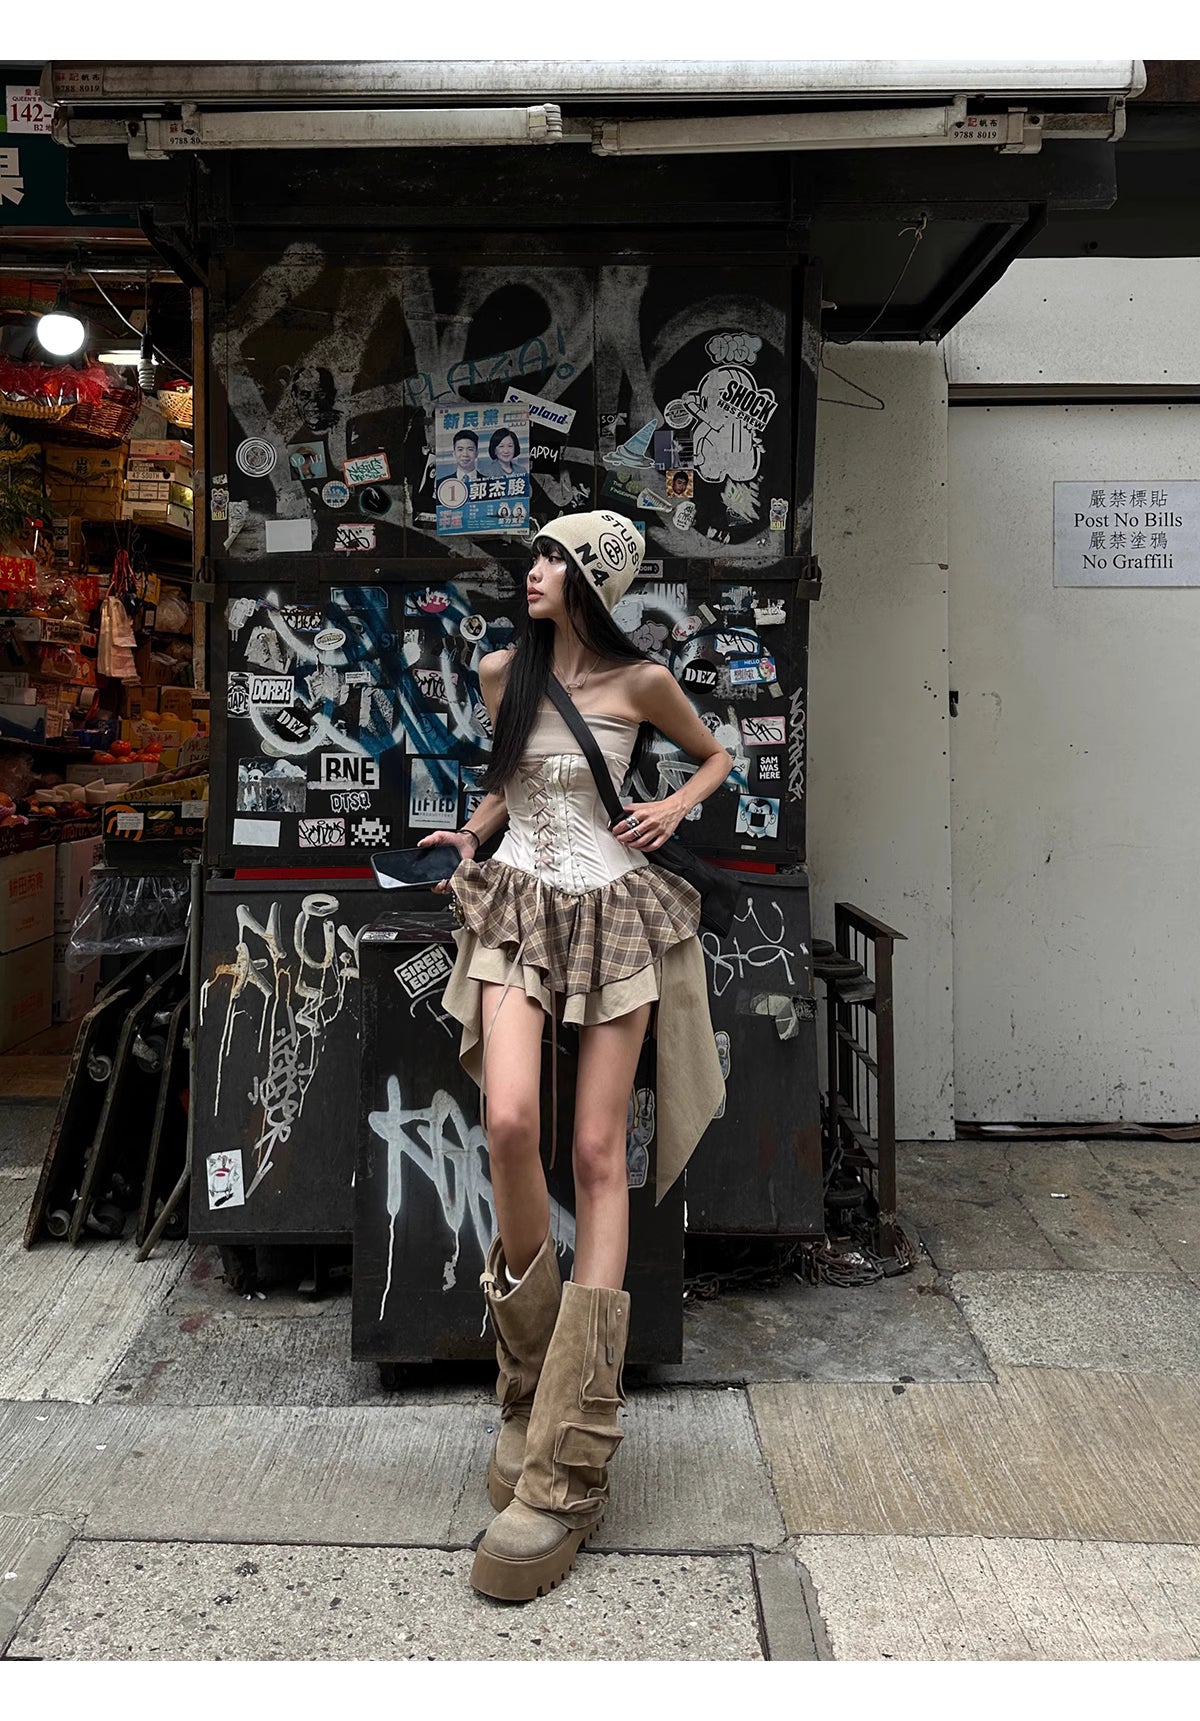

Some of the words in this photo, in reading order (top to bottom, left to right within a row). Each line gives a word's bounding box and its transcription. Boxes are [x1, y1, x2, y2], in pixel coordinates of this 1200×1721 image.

[79, 85, 100, 93] 8019
[953, 131, 974, 139] 9788
[976, 131, 997, 139] 8019
[721, 379, 778, 425] SHOCK
[442, 408, 499, 430] 新民黨
[449, 485, 456, 502] 1
[469, 478, 526, 501] 郭杰駿
[1088, 489, 1168, 508] 嚴禁標貼
[1074, 513, 1109, 527] Post
[1114, 513, 1139, 527] No
[1145, 512, 1183, 527] Bills
[1088, 531, 1168, 550] 嚴禁塗鴉
[1082, 554, 1107, 569] No
[683, 668, 717, 686] DEZ
[250, 678, 292, 705] DOREK
[275, 710, 309, 738] DEZ
[760, 756, 778, 764] SAM
[760, 764, 779, 772] WAS
[759, 771, 781, 780] HERE
[331, 792, 371, 812] DTSQ
[412, 797, 455, 815] LIFTED
[400, 948, 444, 982] SIREN
[408, 959, 448, 990] EDGE
